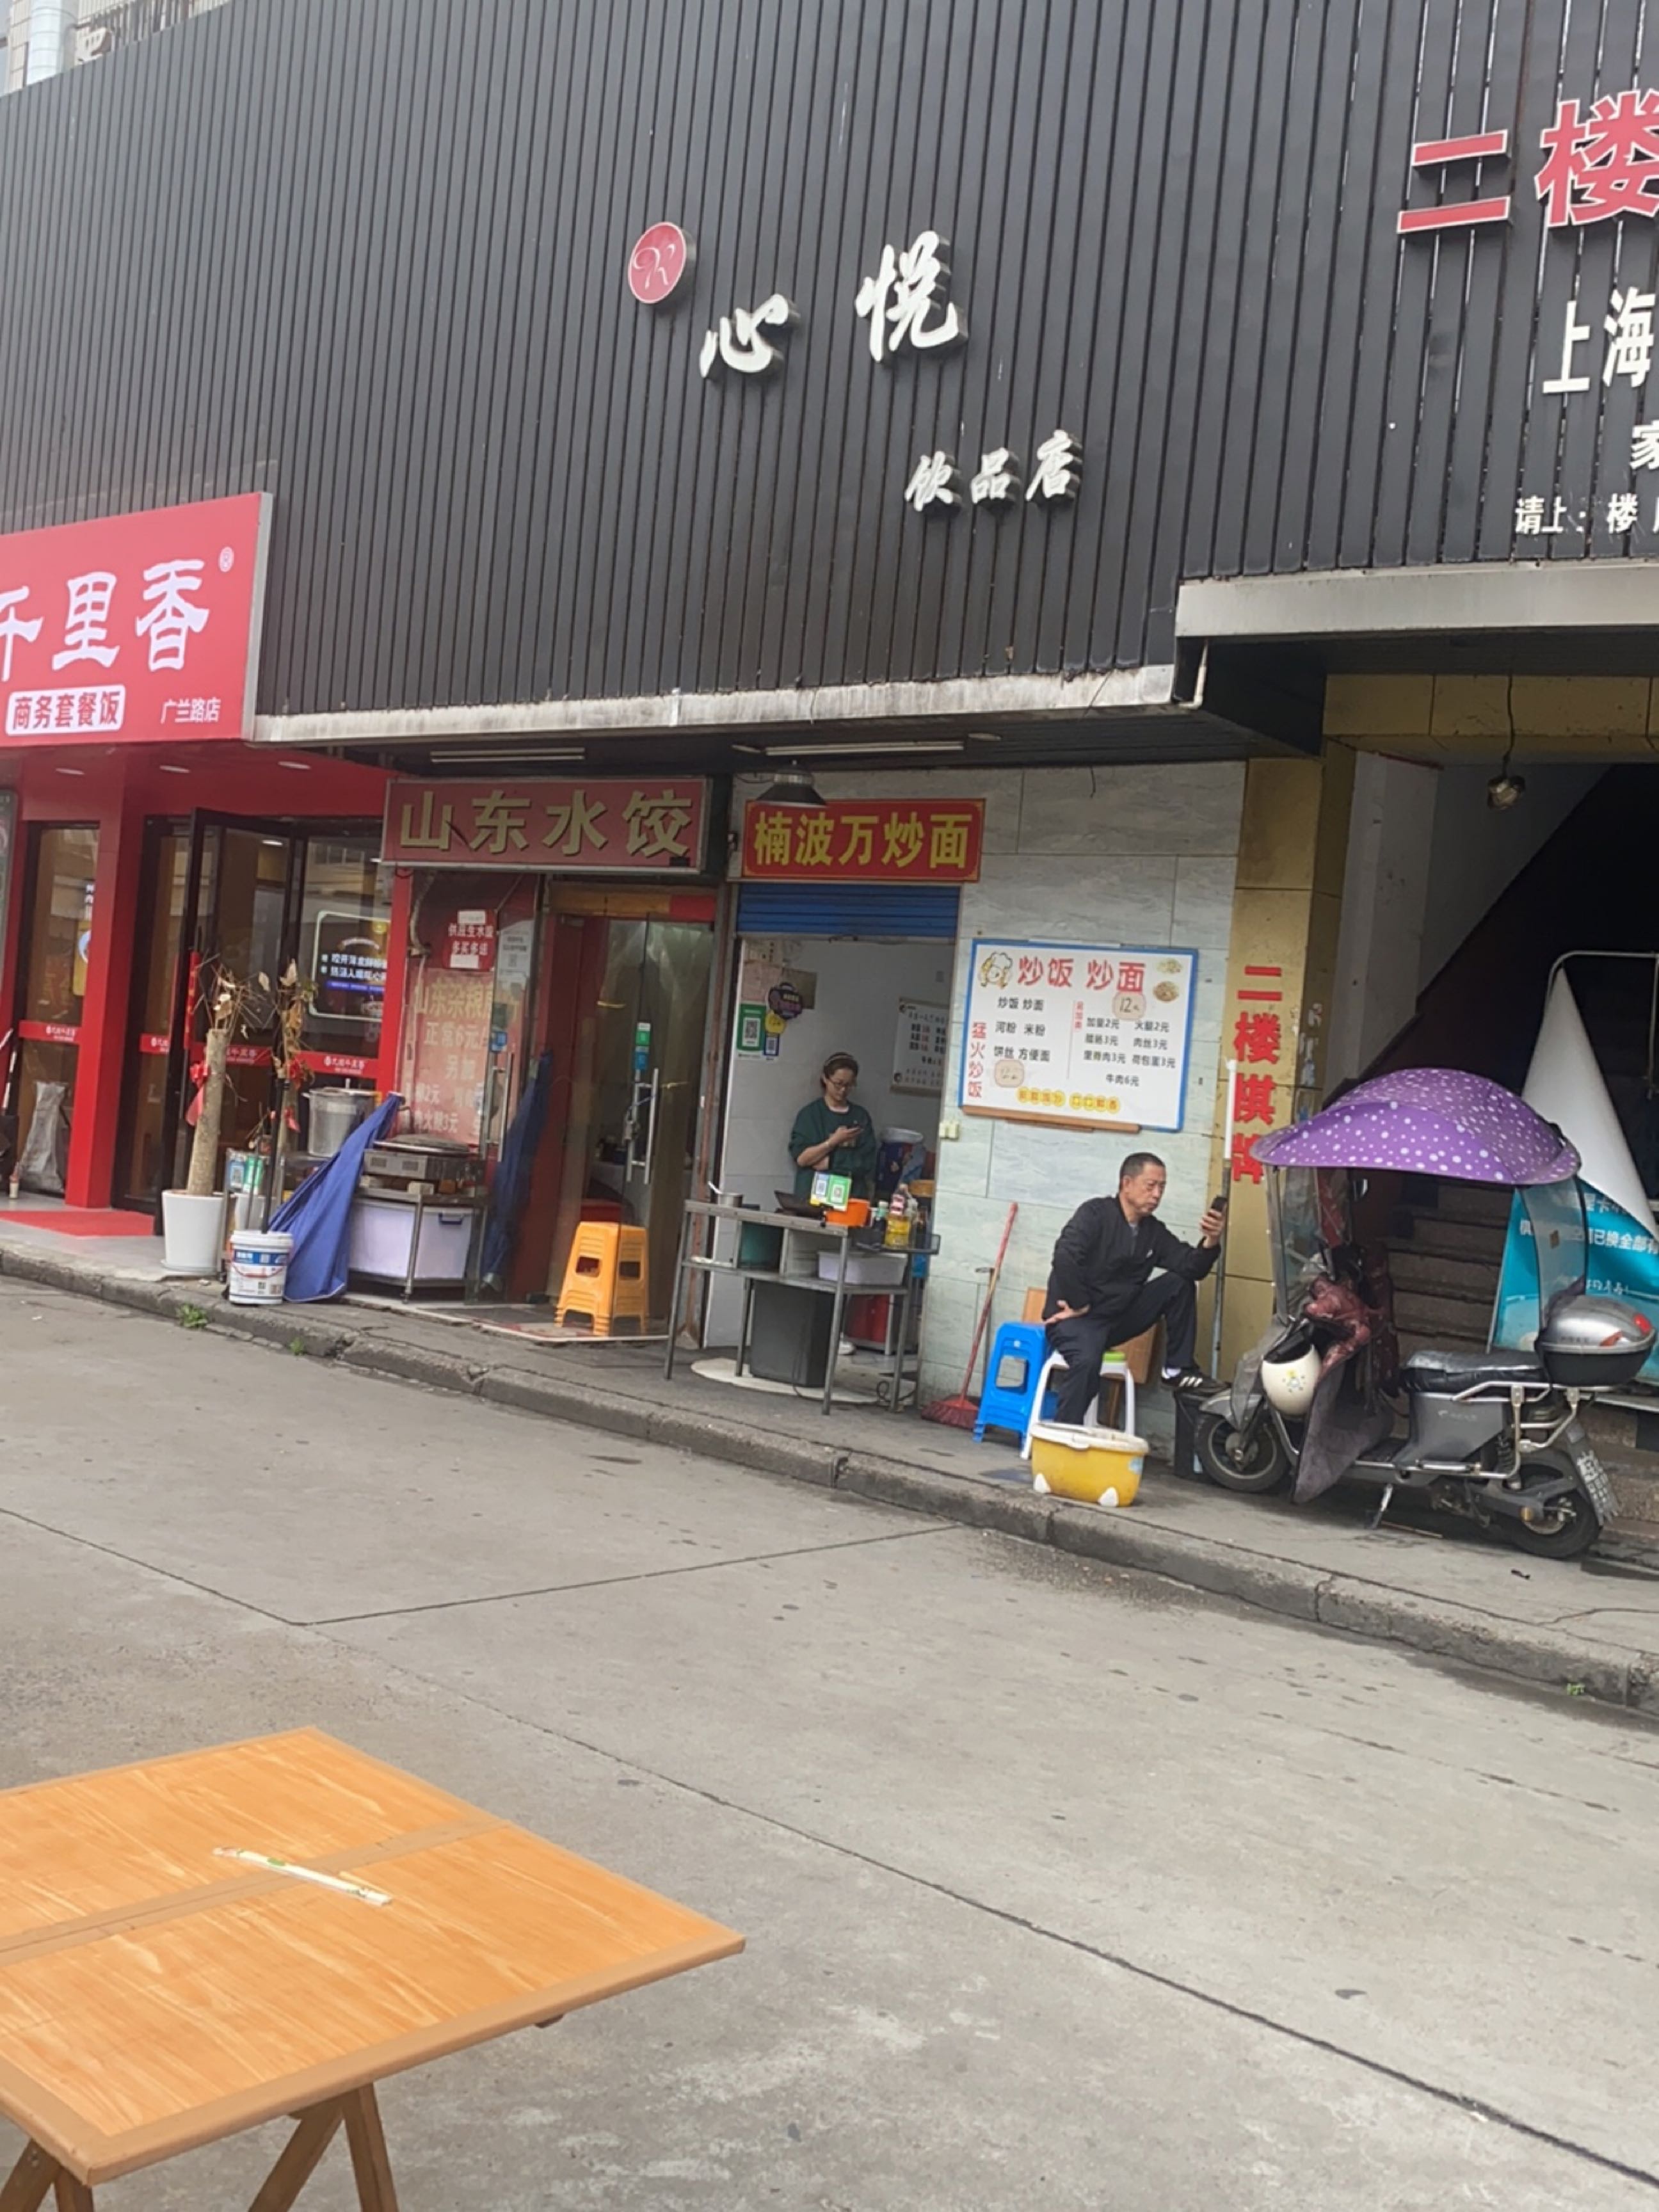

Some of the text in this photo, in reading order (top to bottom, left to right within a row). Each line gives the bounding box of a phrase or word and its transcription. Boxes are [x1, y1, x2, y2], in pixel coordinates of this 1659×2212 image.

[1397, 89, 1659, 234] 二楼
[700, 230, 959, 378] 心悦
[1543, 287, 1656, 394] 上海
[905, 429, 1073, 512] 饮品店
[0, 558, 210, 682] 千里香
[12, 691, 118, 730] 商务套餐饭
[161, 698, 221, 725] 广兰路店
[400, 789, 693, 858] 山东水饺
[753, 811, 973, 869] 楠波万炒面
[1018, 956, 1146, 993] 炒饭 炒面
[968, 1022, 987, 1098] 猛火炒饭
[1018, 1047, 1050, 1062] 方便面
[1106, 1074, 1140, 1087] 牛肉6元
